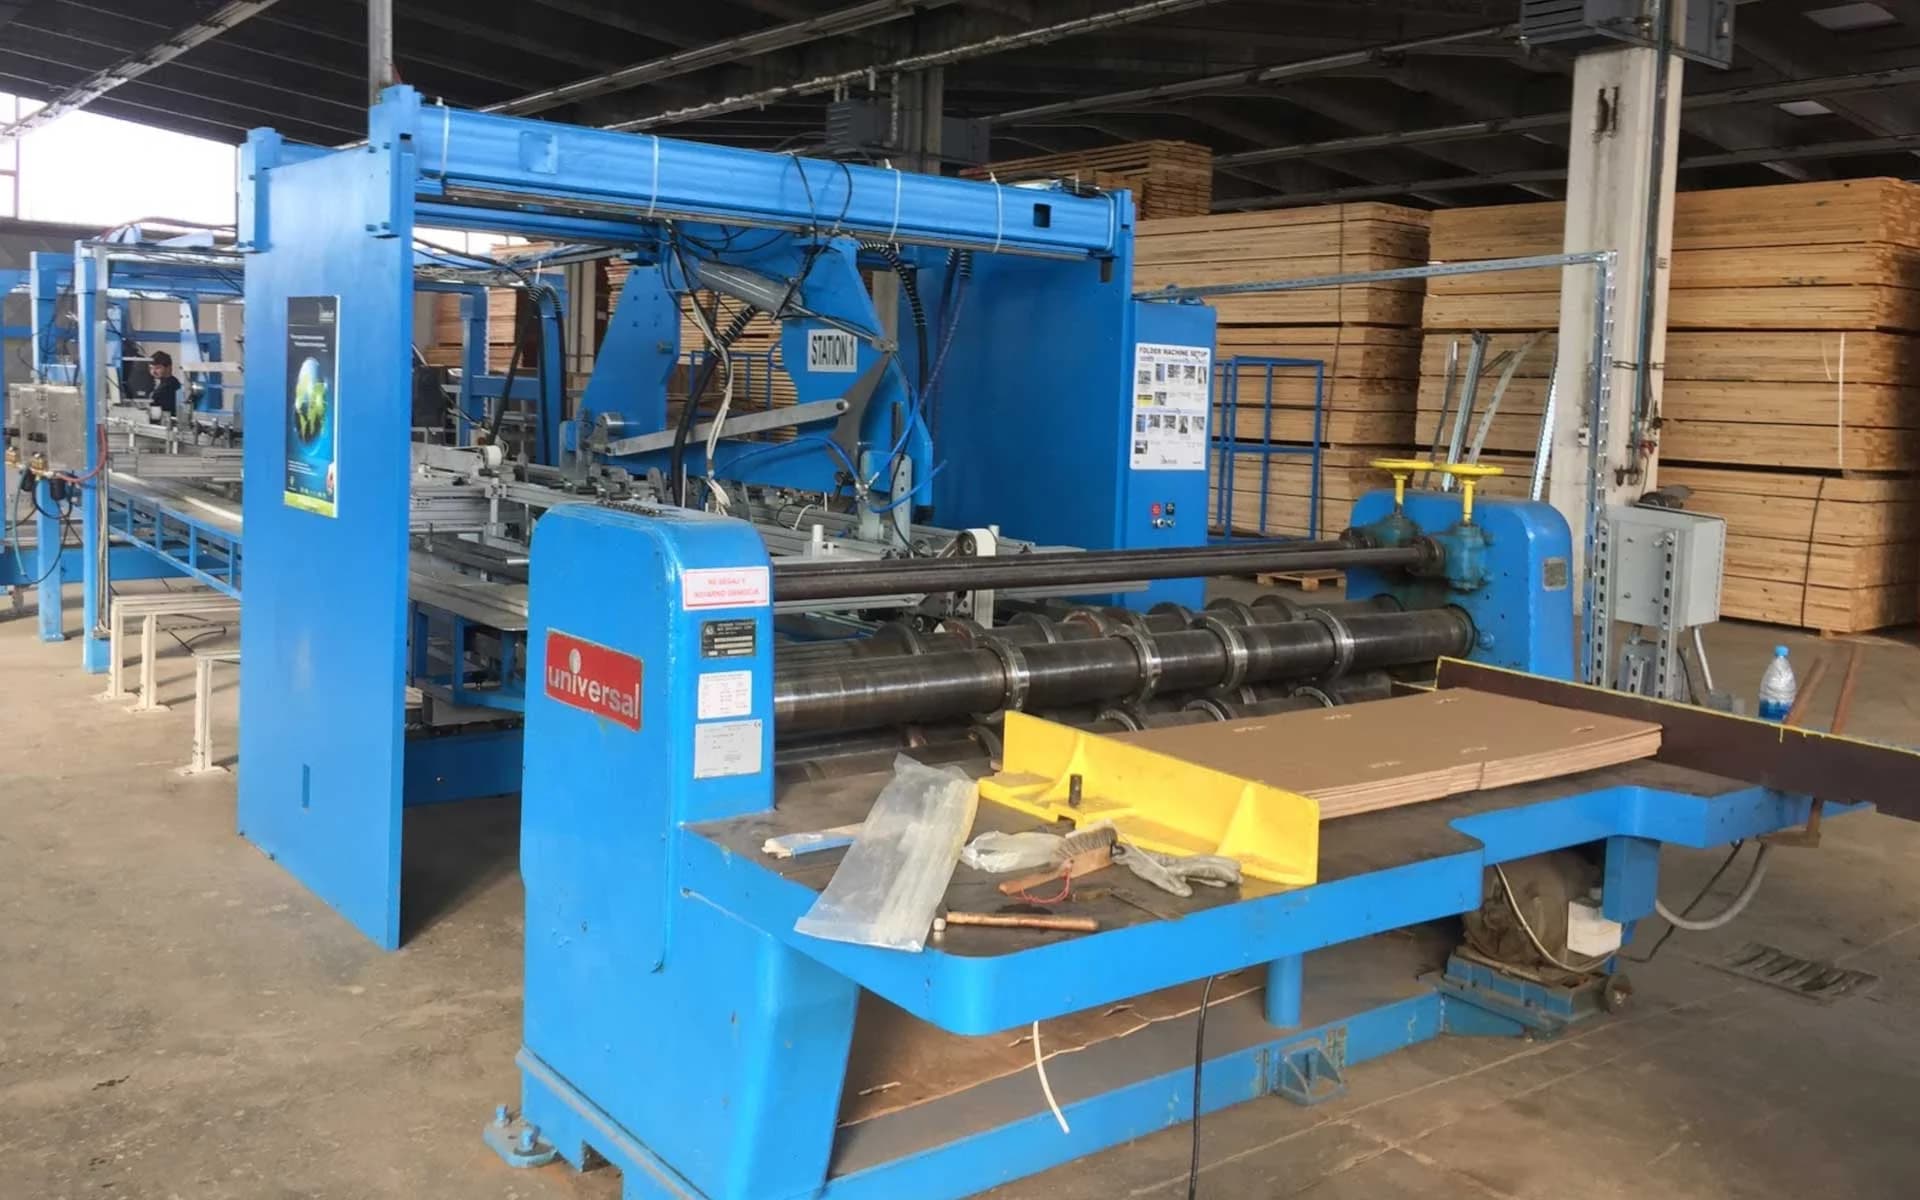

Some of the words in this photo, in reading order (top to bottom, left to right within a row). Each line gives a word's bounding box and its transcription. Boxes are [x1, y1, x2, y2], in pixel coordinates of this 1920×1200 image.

[812, 335, 848, 366] STATION
[850, 335, 854, 366] 1
[548, 648, 640, 720] universal
